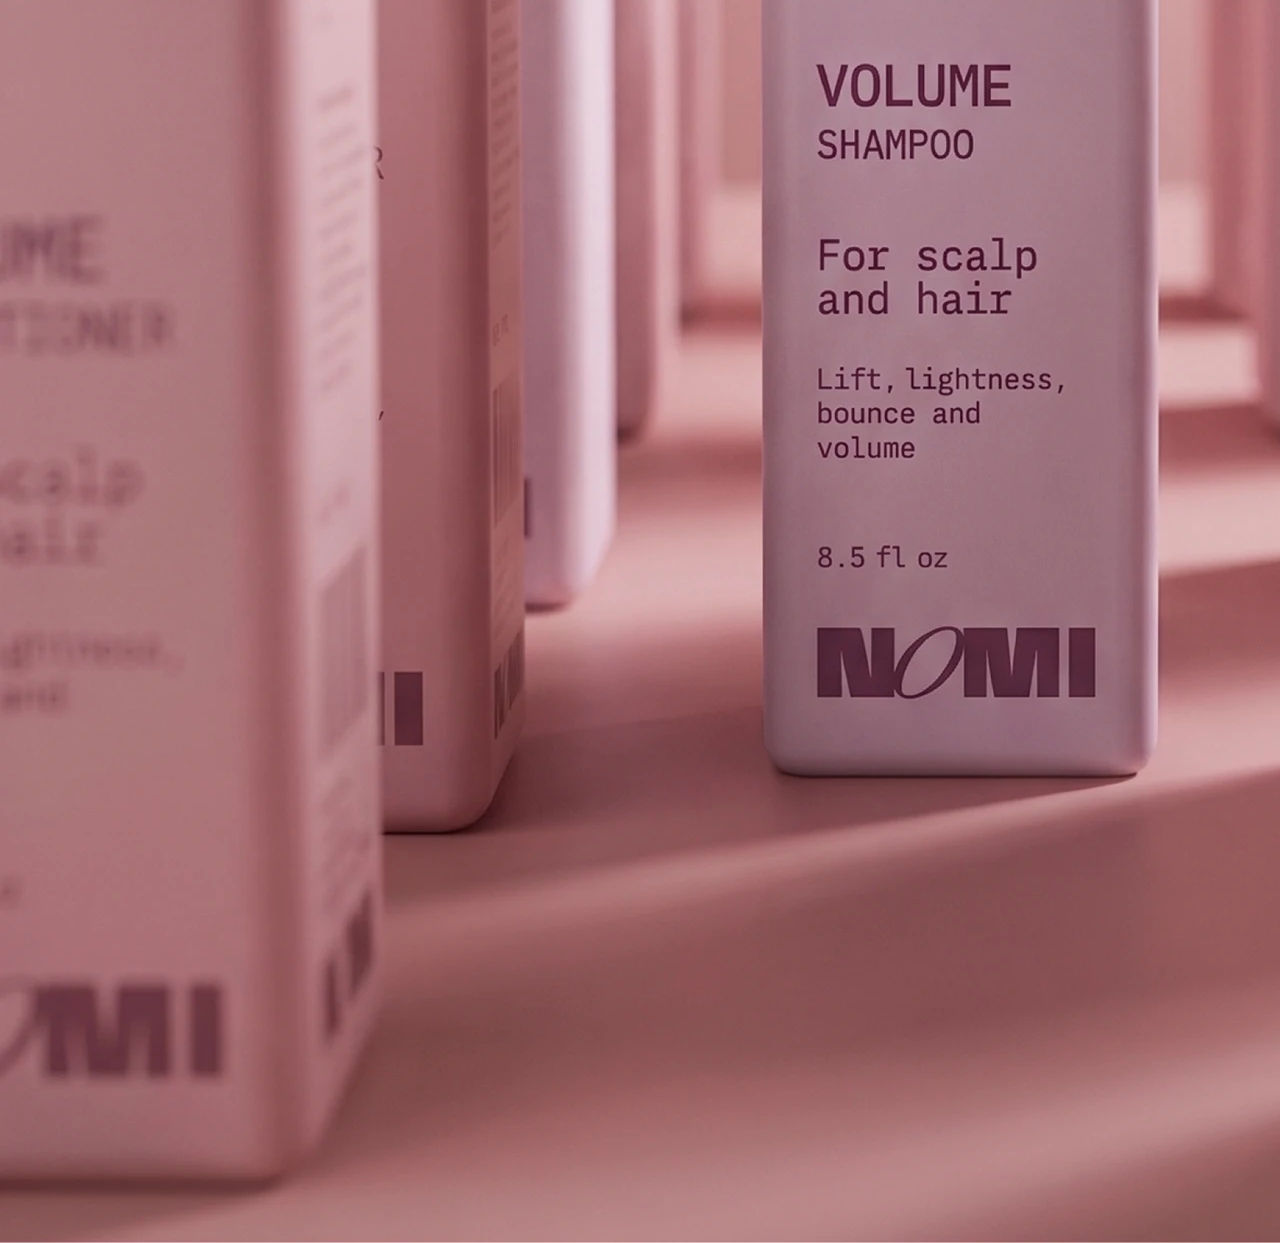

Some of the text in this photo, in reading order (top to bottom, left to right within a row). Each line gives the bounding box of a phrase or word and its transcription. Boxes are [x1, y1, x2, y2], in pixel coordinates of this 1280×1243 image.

[815, 63, 1012, 108] VOLUME
[817, 128, 974, 161] SHAMPOO
[819, 237, 1037, 280] For scalp
[818, 279, 1012, 315] and hair
[817, 400, 980, 425] bounce and
[817, 435, 916, 459] volume
[0, 446, 144, 508] calp
[817, 544, 948, 569] 8.5 fl oz
[816, 625, 1097, 700] NOMI
